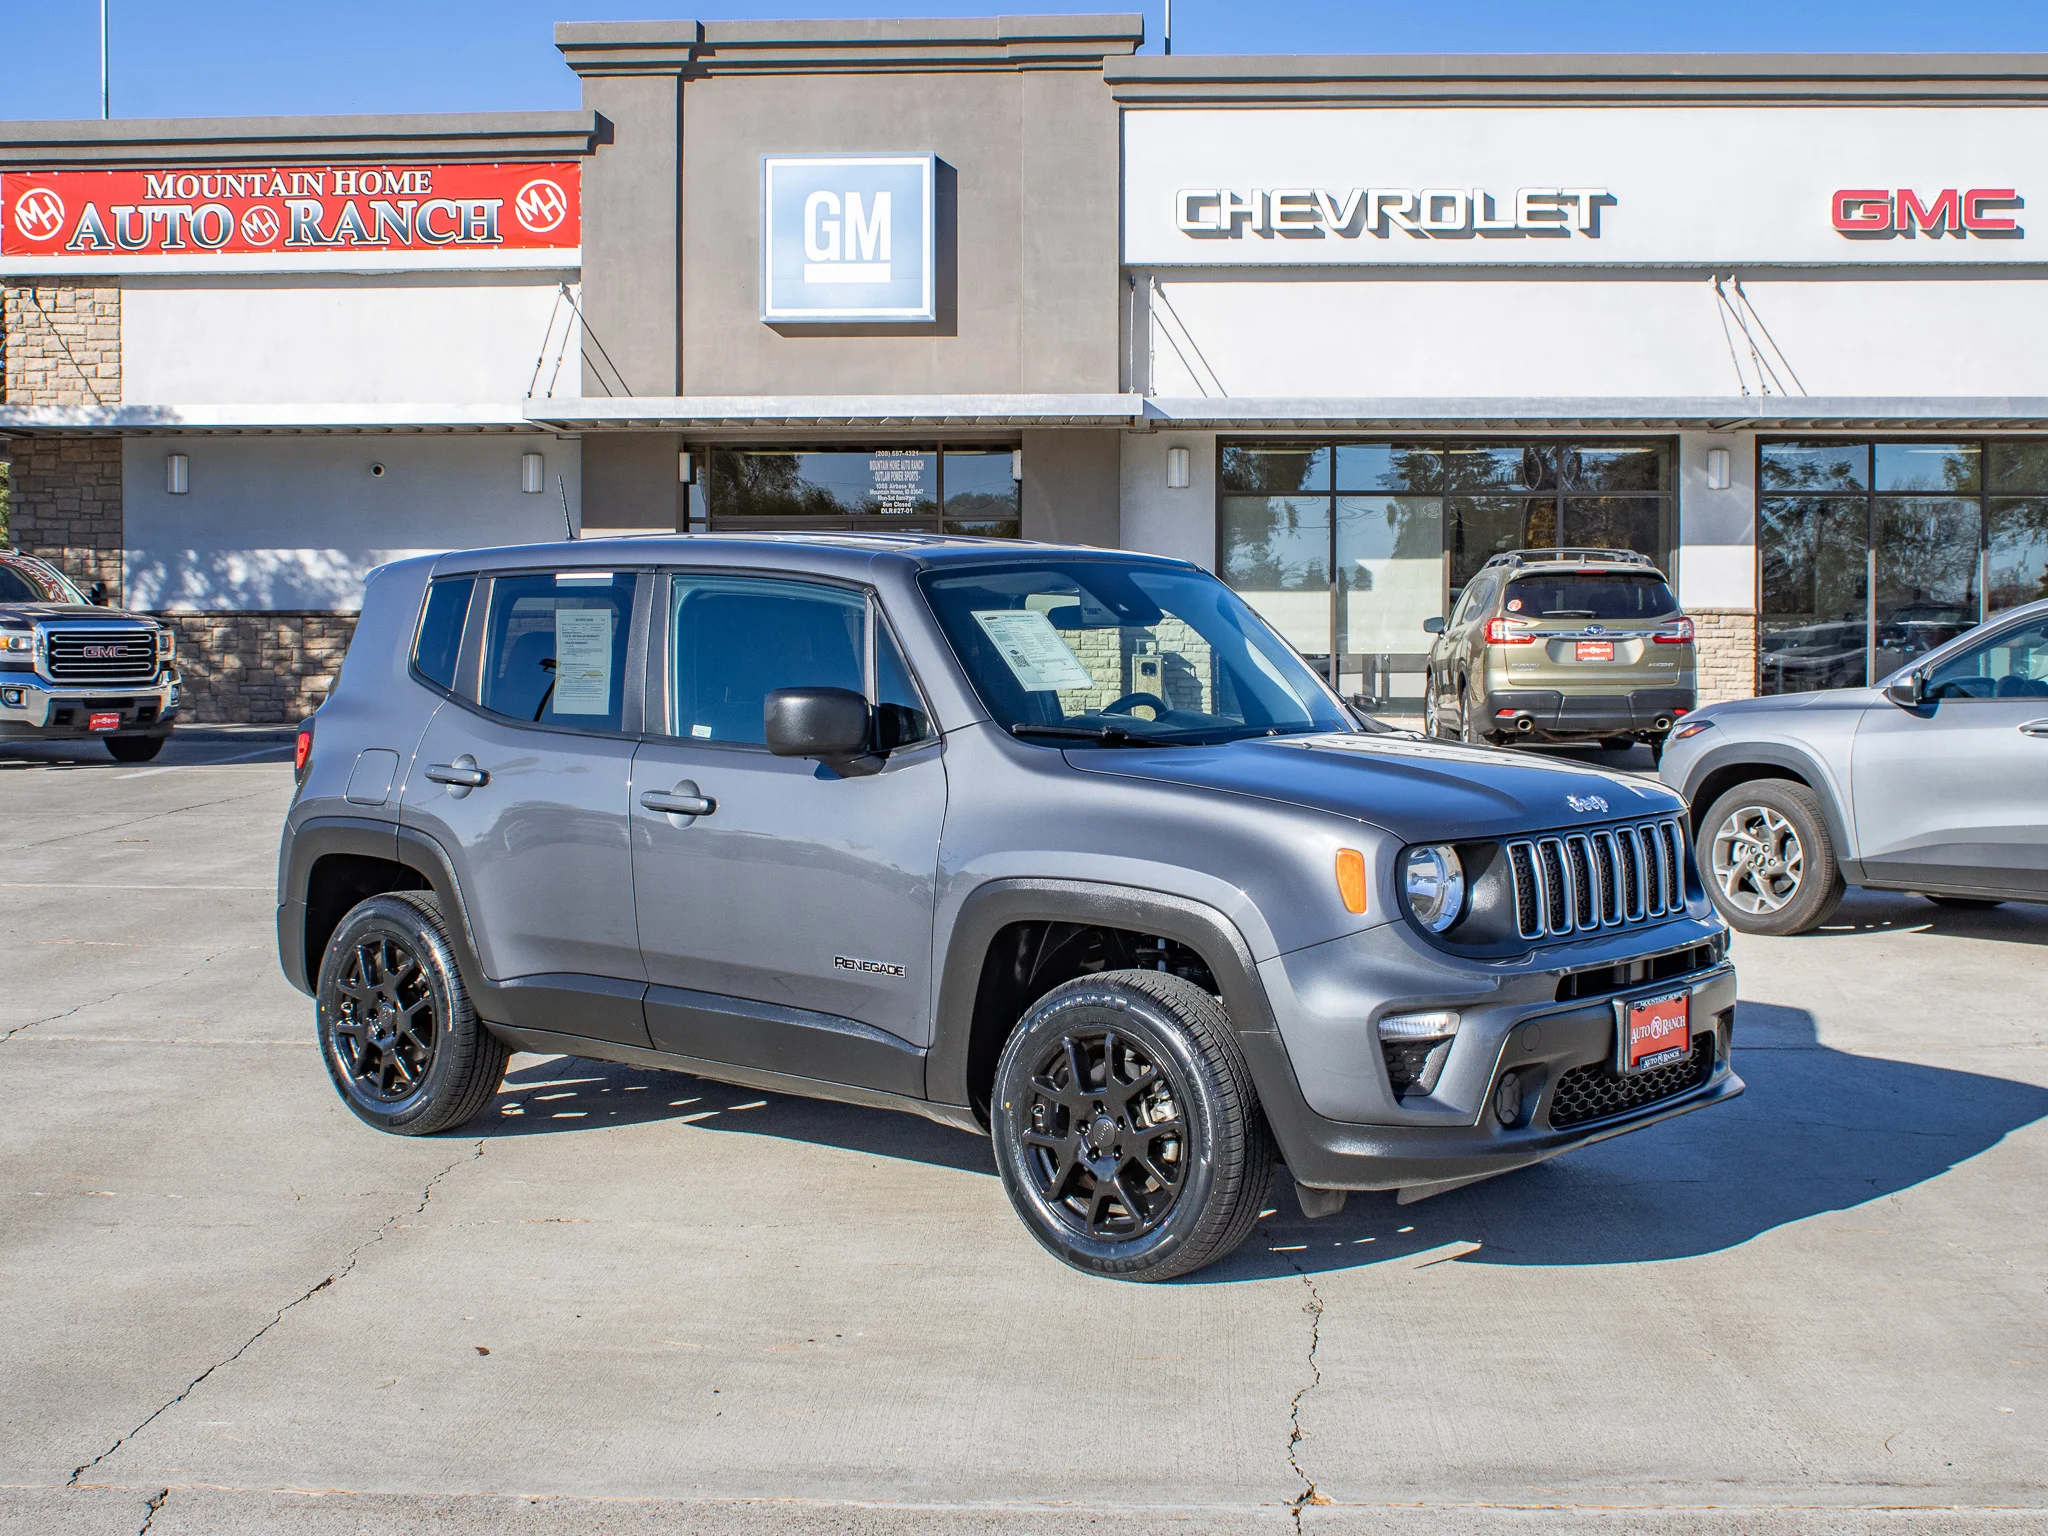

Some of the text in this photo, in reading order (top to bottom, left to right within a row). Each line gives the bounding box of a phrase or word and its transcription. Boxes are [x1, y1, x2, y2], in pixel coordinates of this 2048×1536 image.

[144, 169, 432, 200] MOUNTAIN HOME
[65, 202, 235, 251] AUTO
[284, 198, 504, 247] RANCH
[1176, 187, 1610, 232] CHEVROLET
[1831, 188, 2017, 231] GMC
[804, 190, 892, 262] GM
[83, 646, 129, 659] GMC
[1566, 794, 1609, 813] Jeep
[834, 955, 906, 978] RENEGADE
[1630, 1025, 1651, 1045] AUTO
[1661, 1015, 1687, 1036] RANCH
